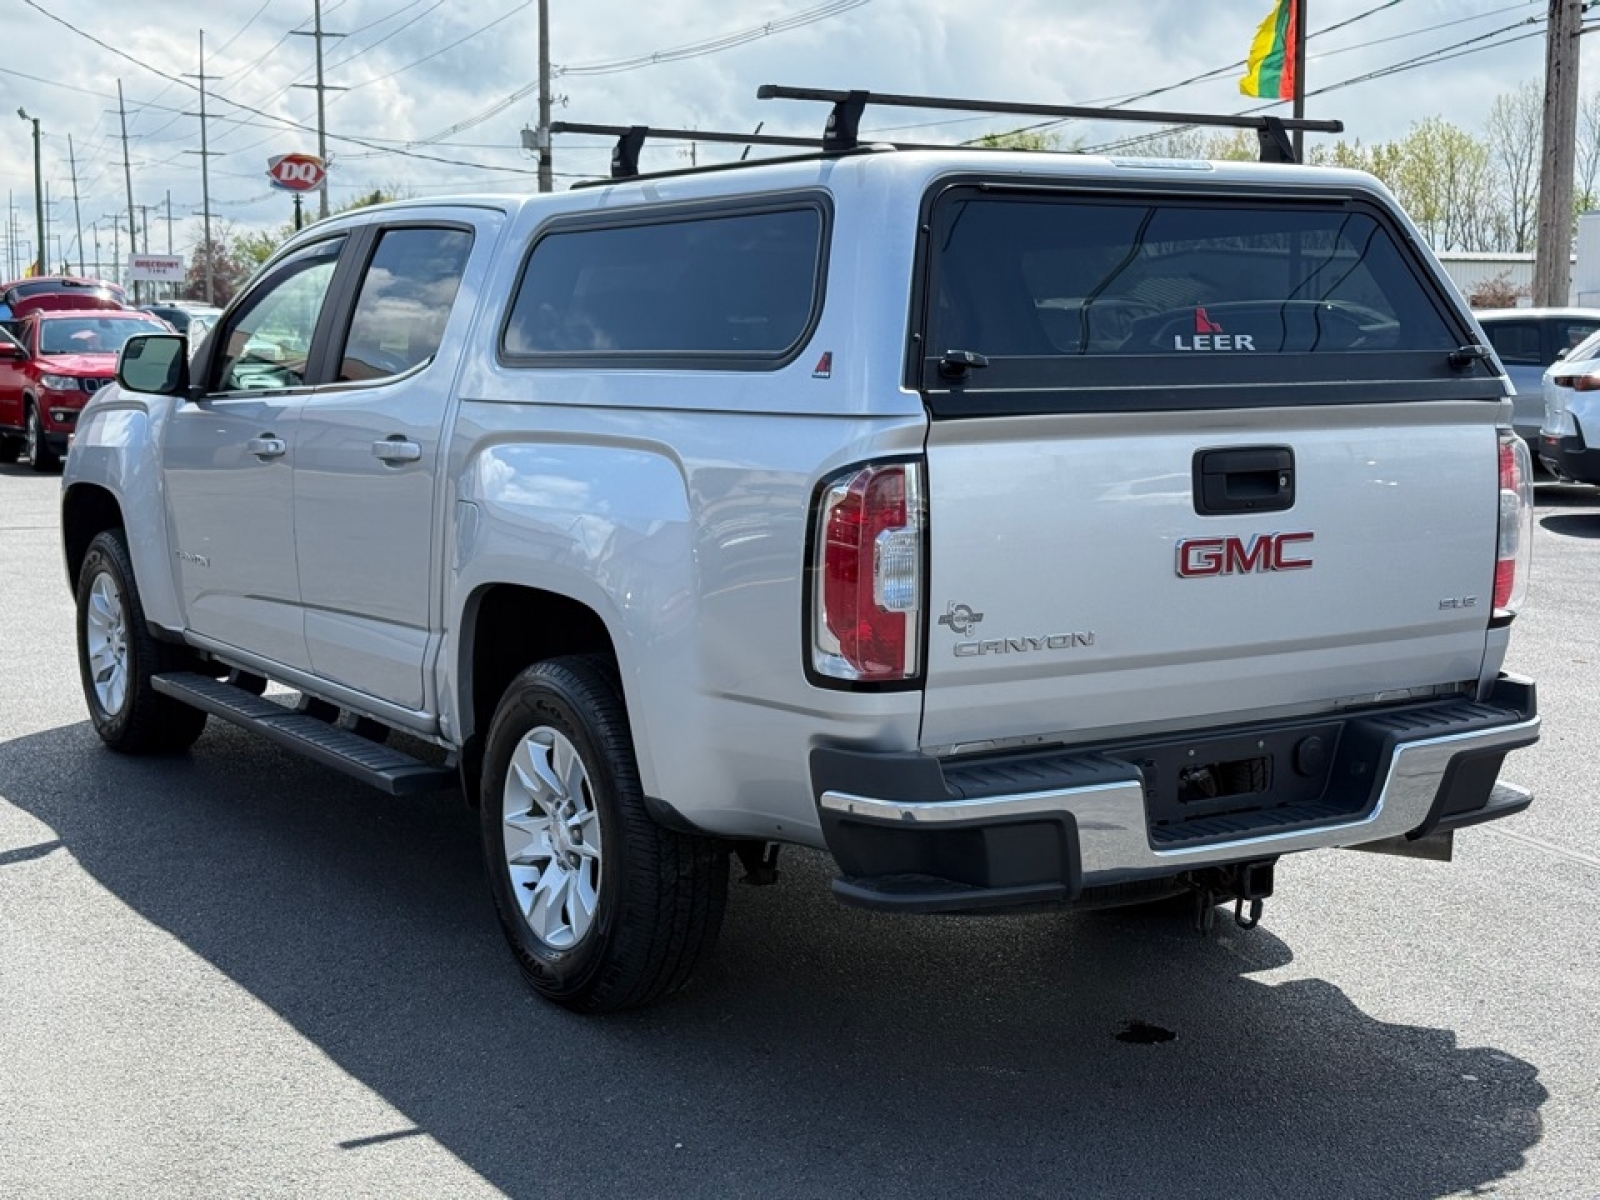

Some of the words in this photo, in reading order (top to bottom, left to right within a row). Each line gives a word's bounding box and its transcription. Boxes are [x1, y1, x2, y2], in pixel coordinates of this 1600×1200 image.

[280, 161, 317, 184] DQ
[1174, 334, 1256, 351] LEER
[1175, 532, 1314, 577] GMC
[953, 630, 1096, 657] CANYON
